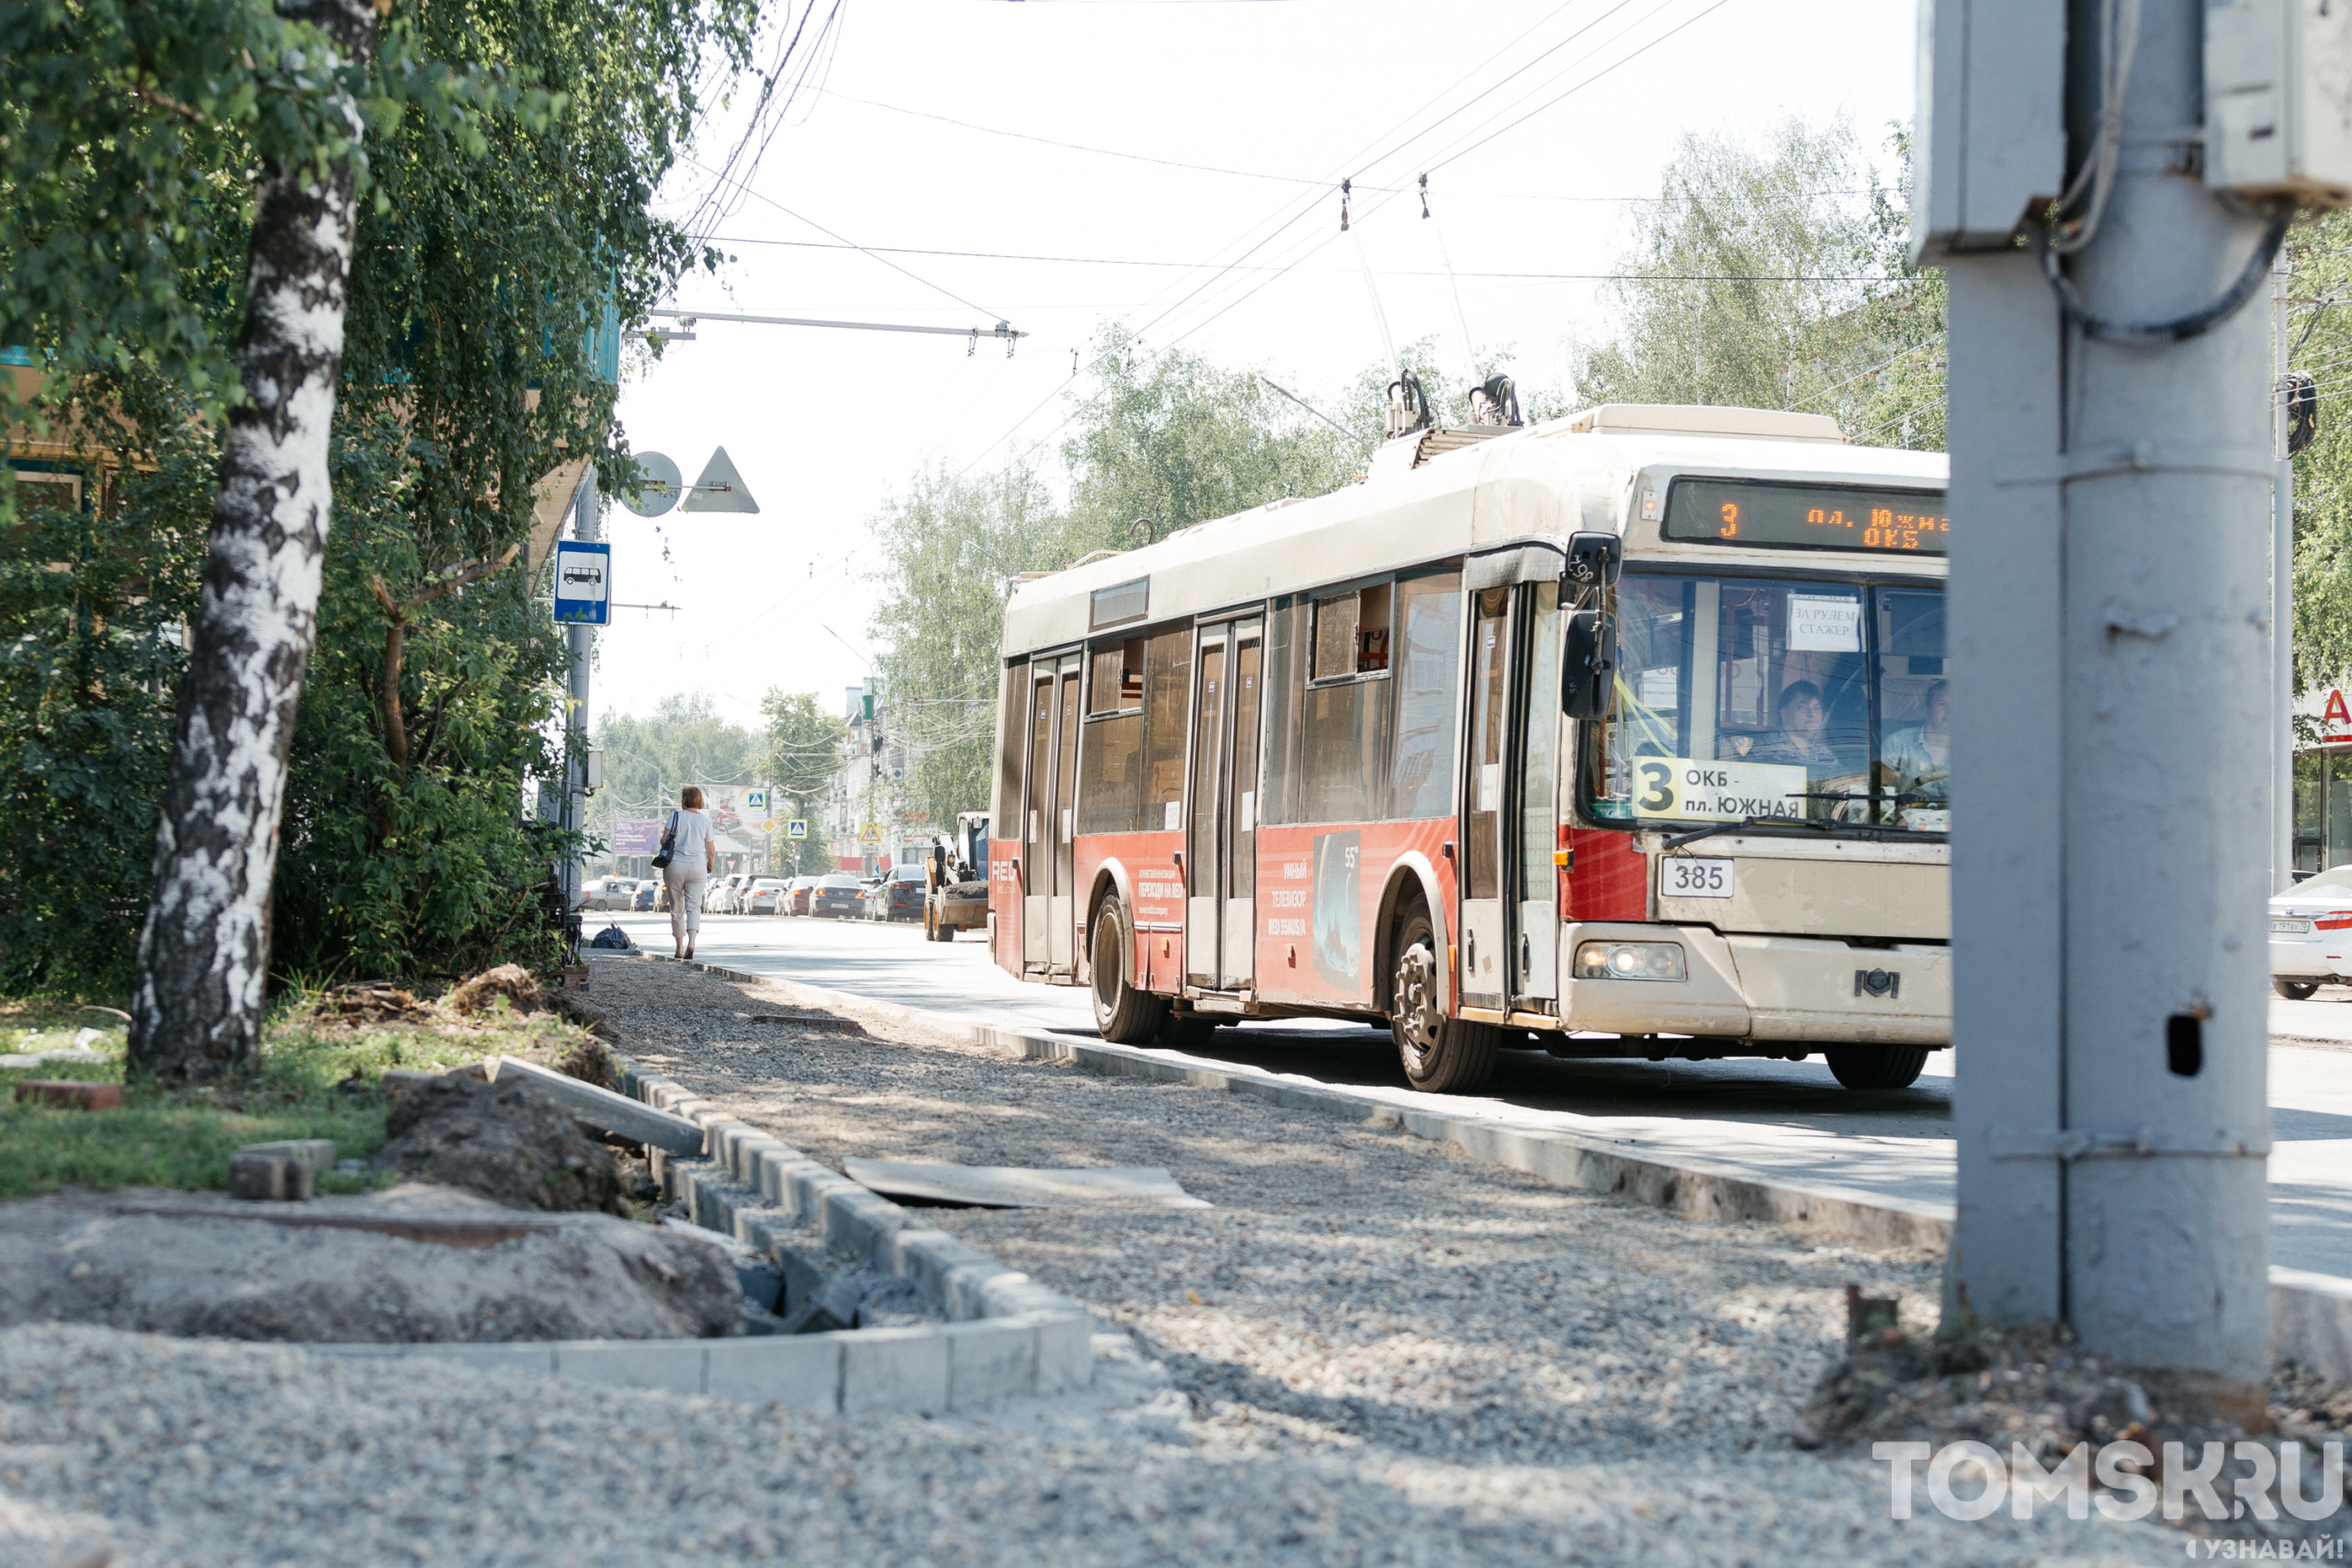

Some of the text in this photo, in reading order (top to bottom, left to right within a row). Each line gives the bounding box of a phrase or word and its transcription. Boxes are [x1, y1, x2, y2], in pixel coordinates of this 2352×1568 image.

[1721, 503, 1737, 536] 3
[1807, 508, 1951, 533] пл. Южна
[1863, 527, 1918, 549] ОКБ
[1795, 608, 1856, 622] ЗА РУЛЕМ
[1799, 624, 1849, 636] СТАЖЕР
[1638, 762, 1674, 812] 3
[1686, 769, 1727, 787] ОКБ
[1685, 796, 1800, 818] пл. ЮЖНАЯ
[992, 861, 1016, 881] RED
[1283, 858, 1306, 880] УМНЫЙ
[1675, 864, 1724, 890] 385
[1138, 882, 1164, 900] ПЕРЕХОДИ
[1272, 890, 1306, 908] ТЕЛЕВИЗОР
[1268, 918, 1280, 935] RED
